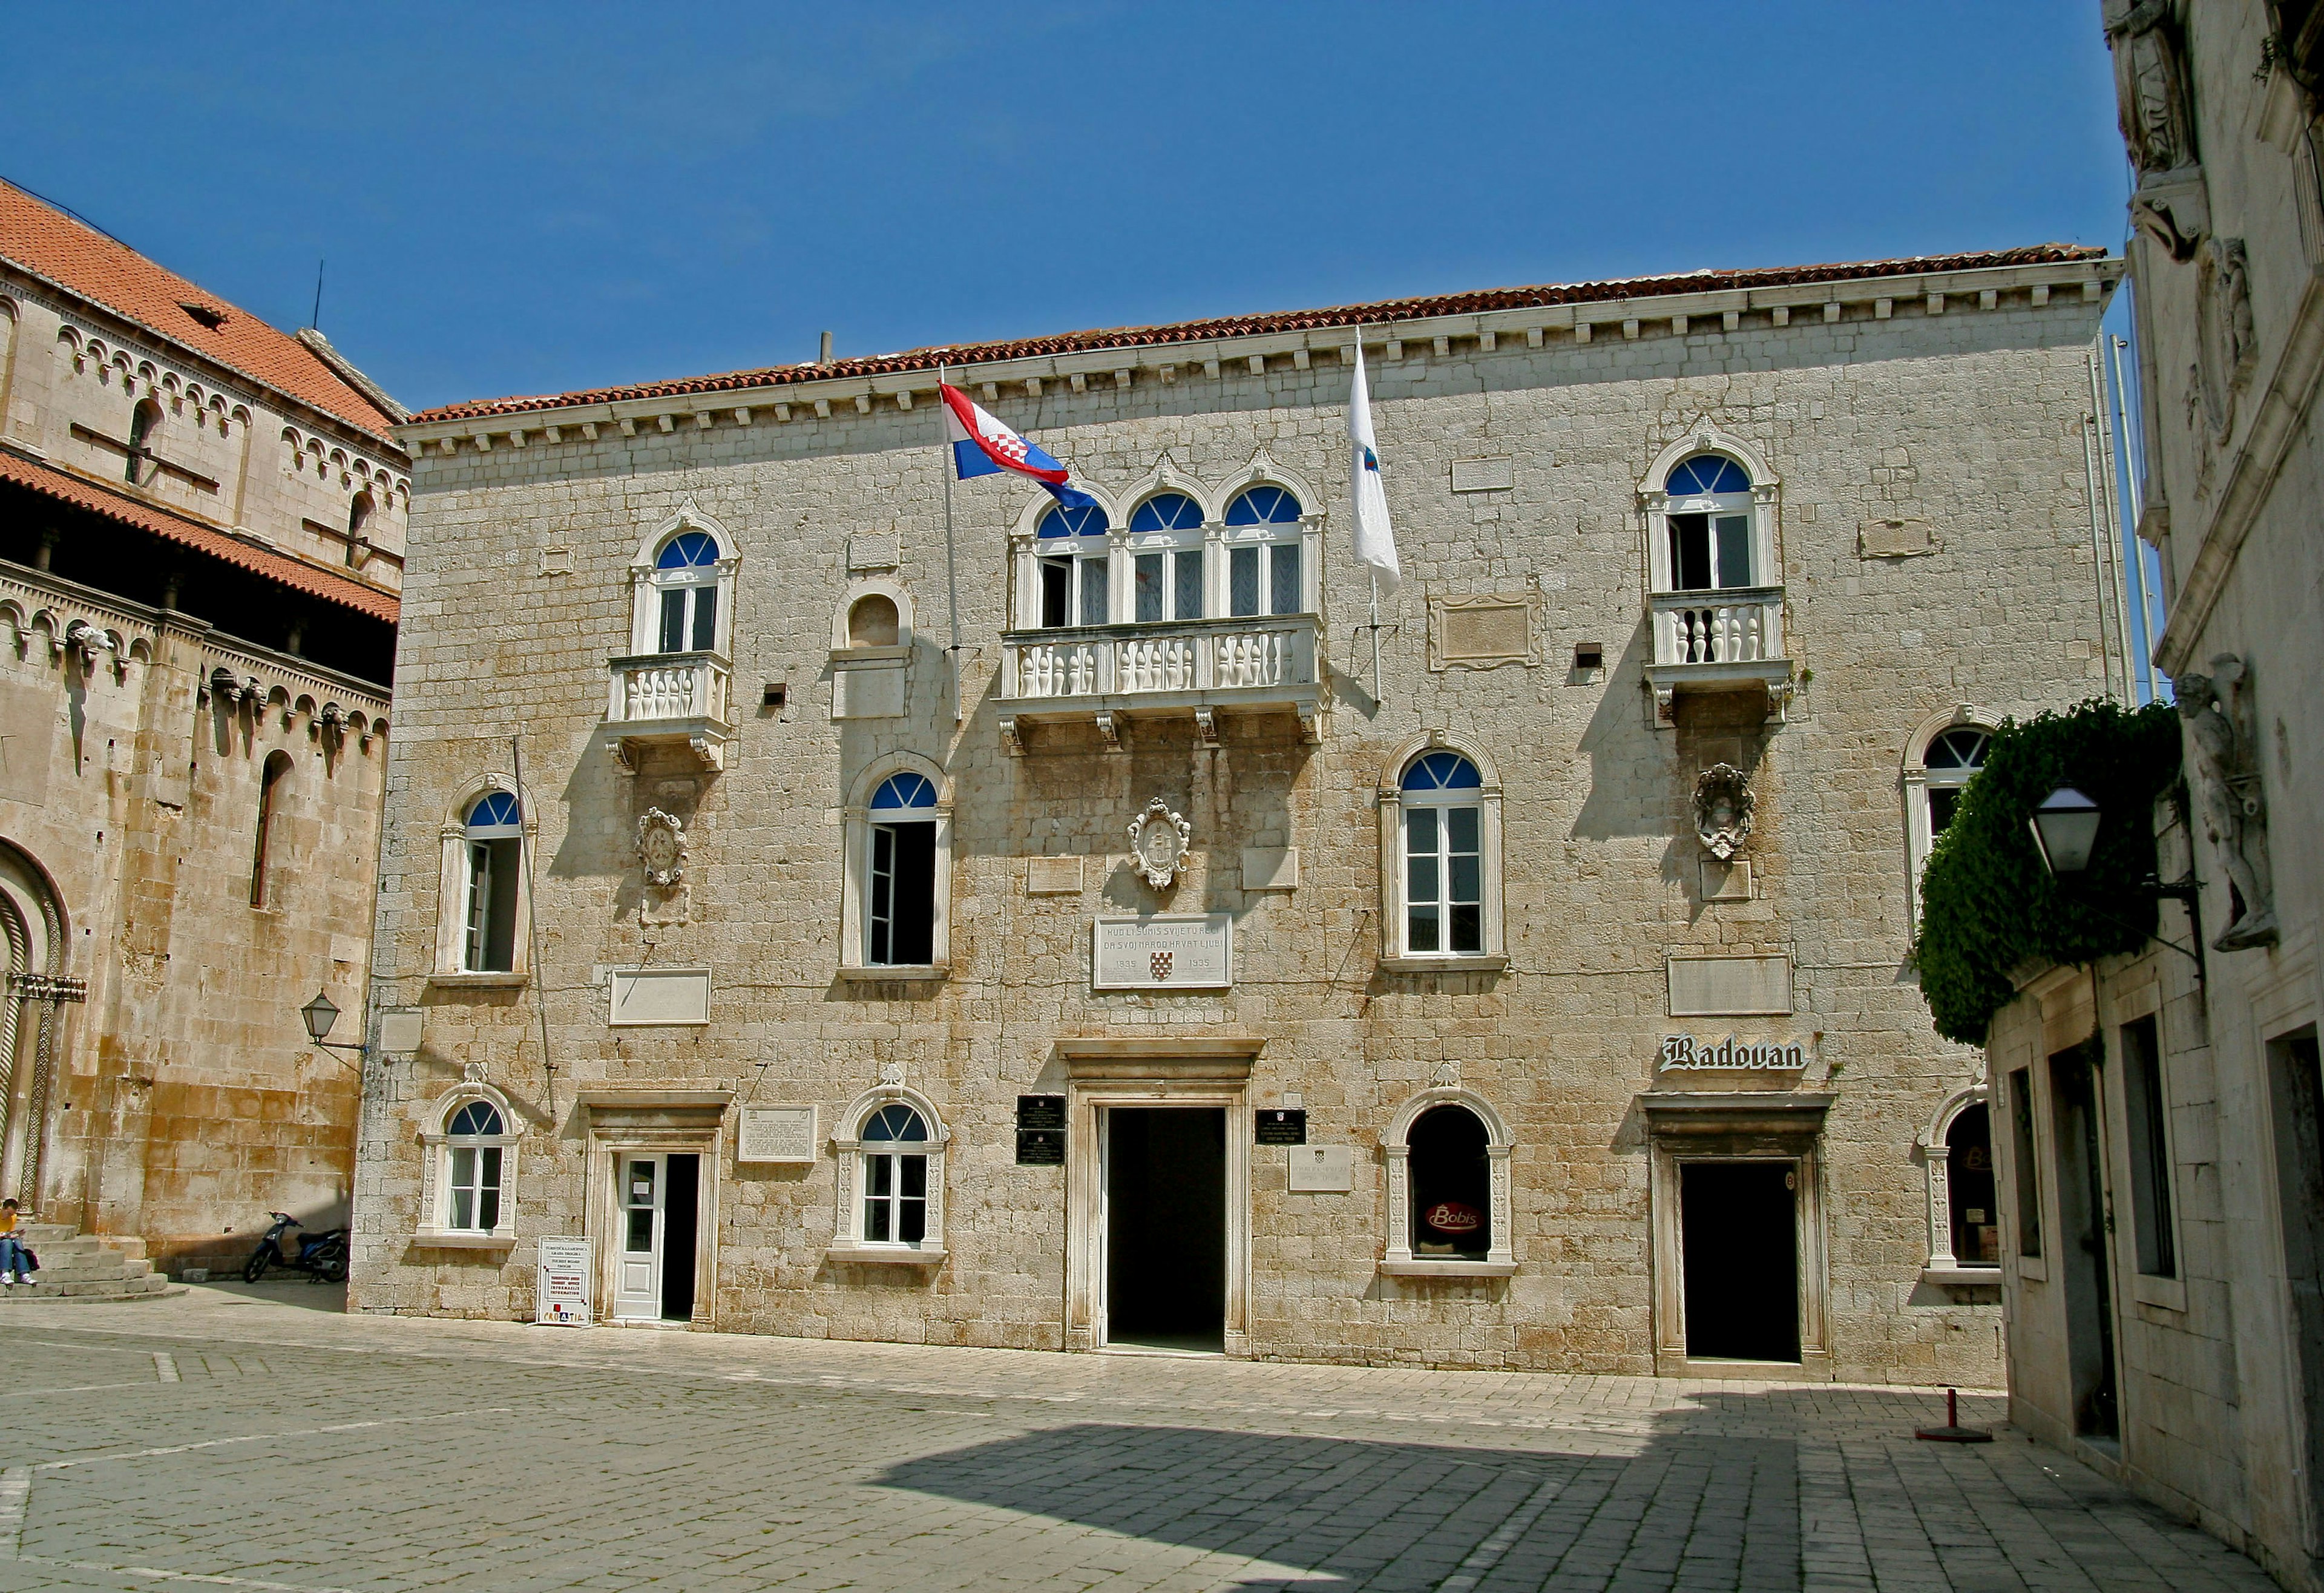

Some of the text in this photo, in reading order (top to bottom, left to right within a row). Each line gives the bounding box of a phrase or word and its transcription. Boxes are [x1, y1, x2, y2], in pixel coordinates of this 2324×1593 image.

[1164, 927, 1197, 936] SVIJETU
[1117, 942, 1137, 950] SVOJ
[1200, 940, 1222, 949] LJUBI
[1189, 959, 1210, 967] 1935
[1664, 1035, 1805, 1068] Radovan
[1433, 1208, 1477, 1225] Bobis
[544, 1312, 585, 1322] CROATIA
